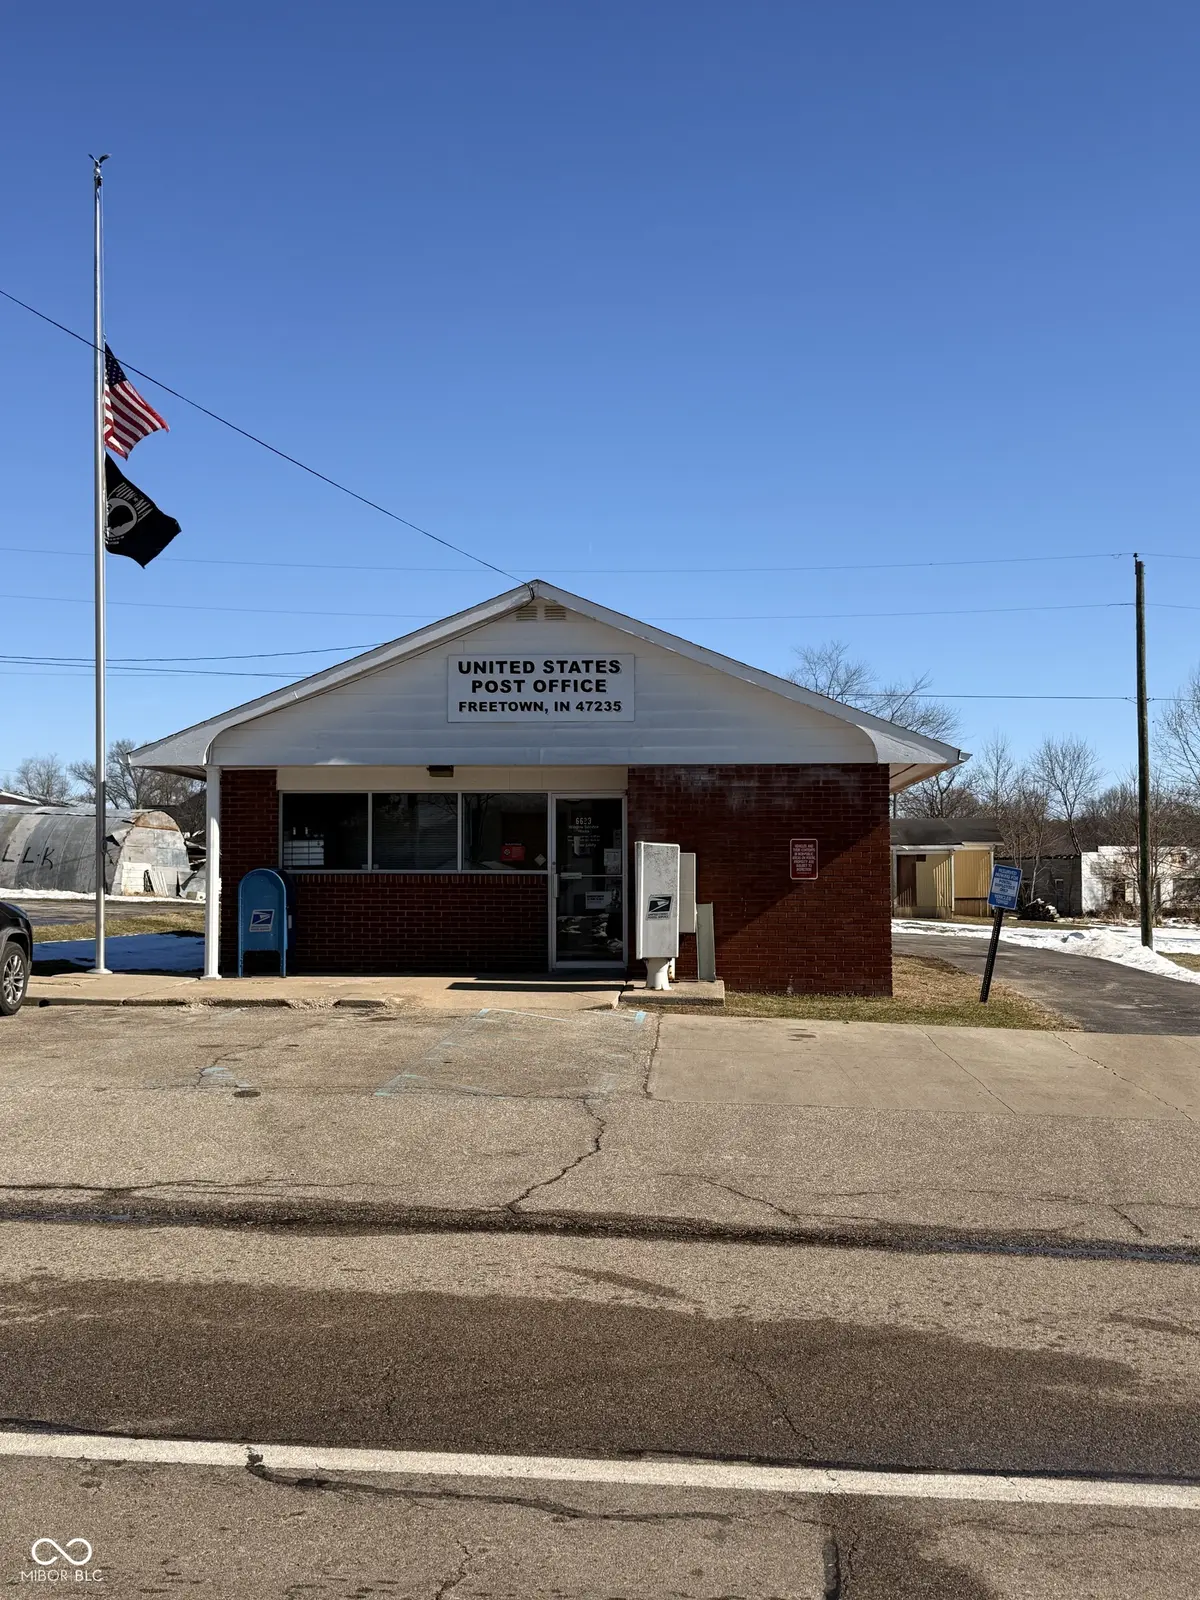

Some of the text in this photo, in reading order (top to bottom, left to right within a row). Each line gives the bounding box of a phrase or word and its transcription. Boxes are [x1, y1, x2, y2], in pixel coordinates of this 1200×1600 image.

[458, 659, 622, 674] UNITED STATES
[471, 679, 607, 693] POST OFFICE
[458, 700, 622, 714] FREETOWN, IN 47235
